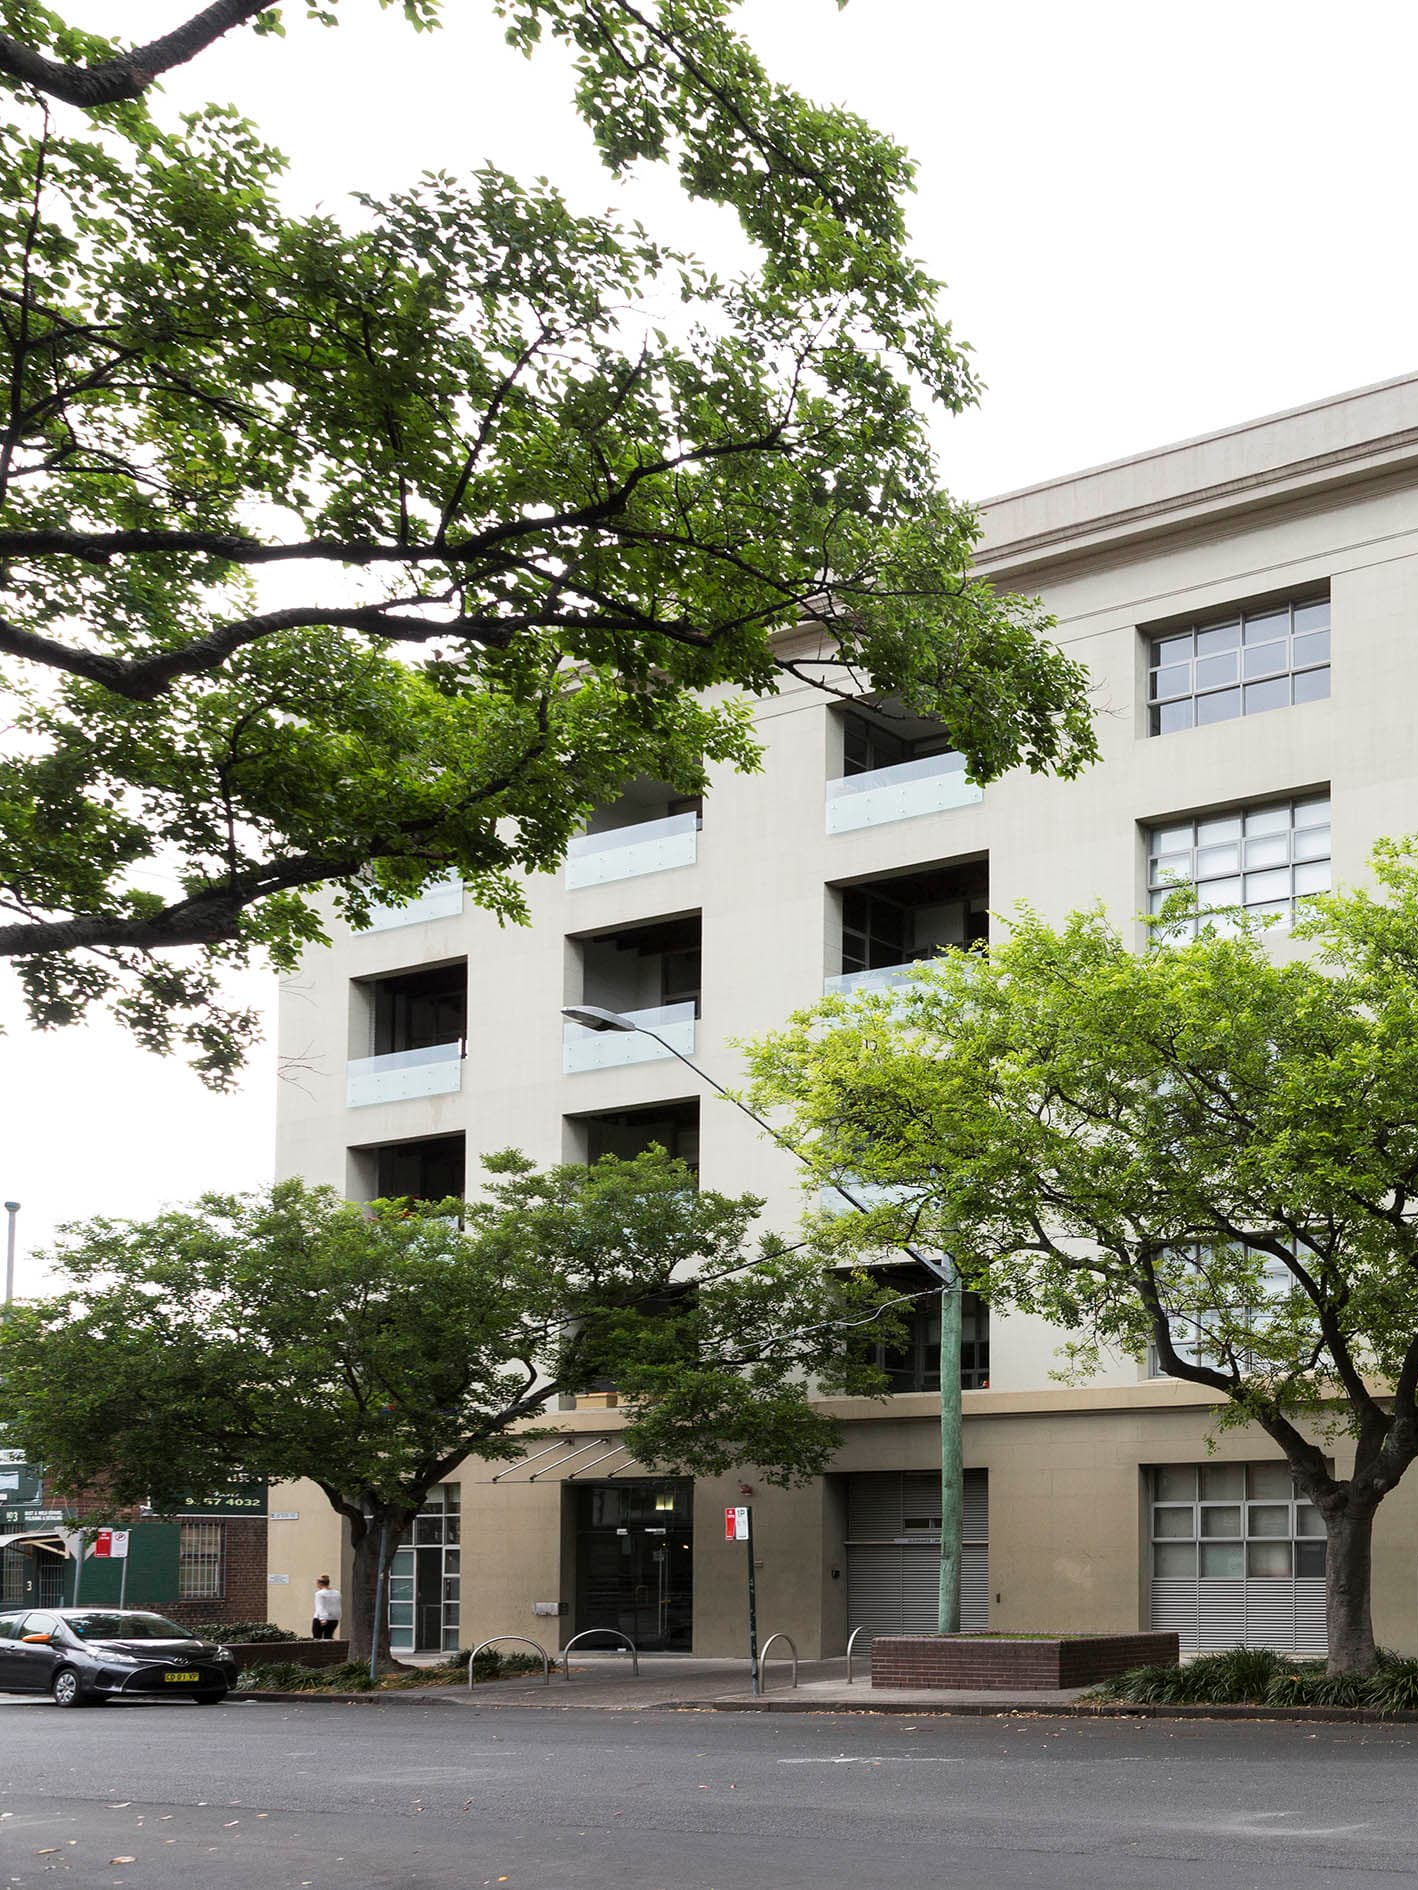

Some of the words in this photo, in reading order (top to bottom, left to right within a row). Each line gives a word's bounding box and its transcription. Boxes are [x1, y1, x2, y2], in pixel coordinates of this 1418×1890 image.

[184, 1497, 222, 1506] 957
[225, 1498, 261, 1507] 4032
[26, 1580, 32, 1592] 3
